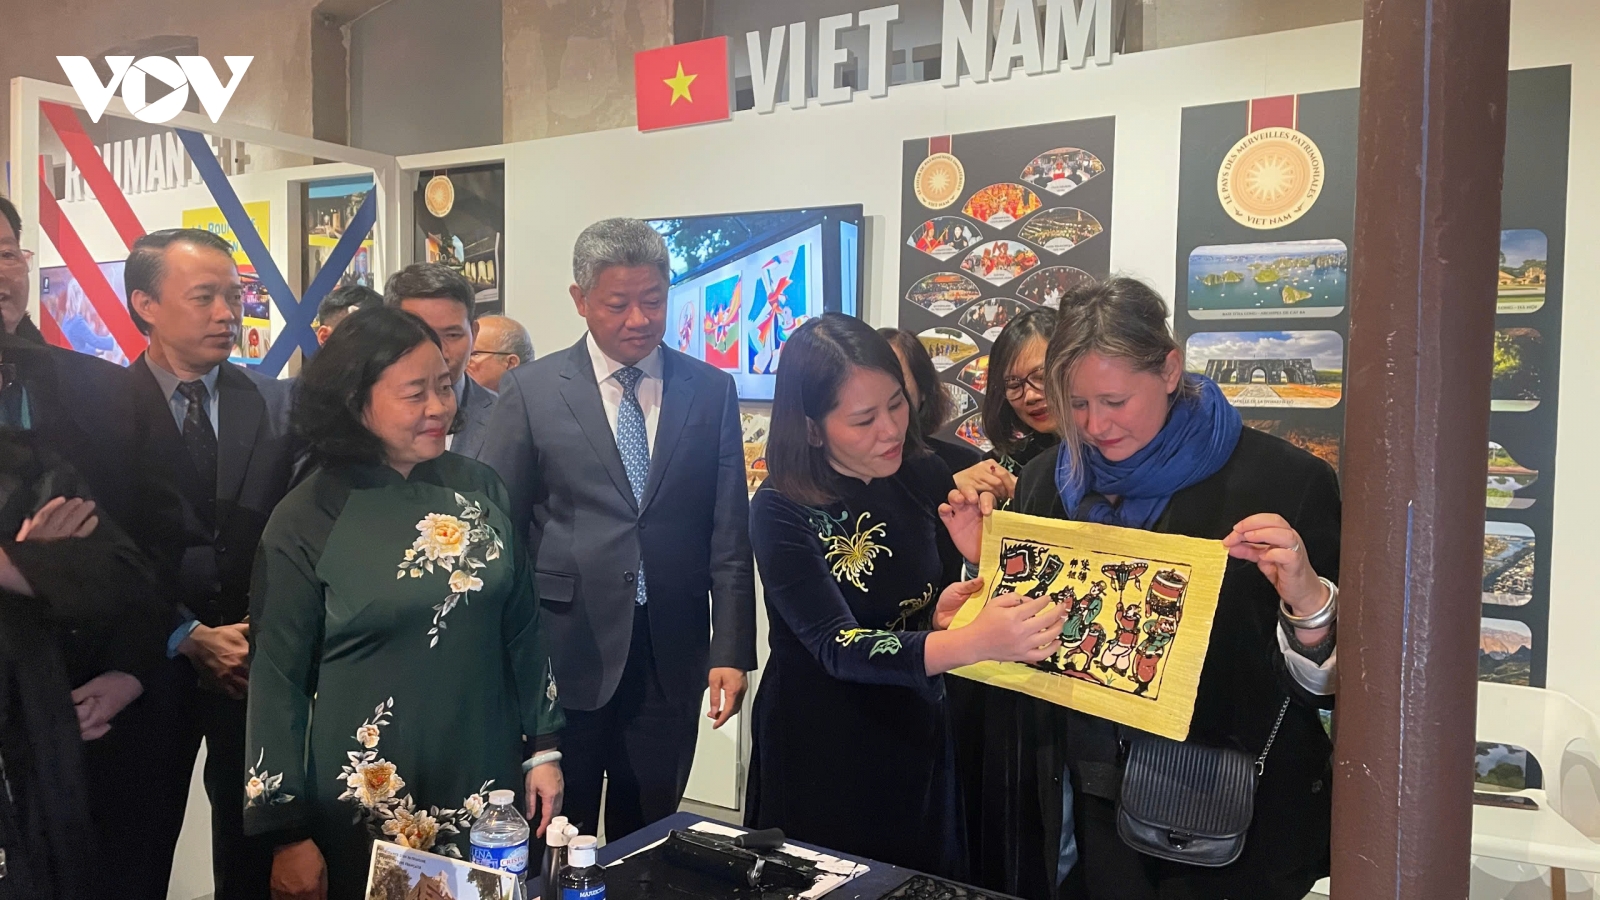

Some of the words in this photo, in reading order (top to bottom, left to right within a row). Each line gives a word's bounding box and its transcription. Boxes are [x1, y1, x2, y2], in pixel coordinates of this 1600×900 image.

[745, 4, 899, 113] VIET
[941, 0, 1113, 87] NAM
[1236, 131, 1291, 155] MERVEILLES
[1224, 153, 1238, 170] DES
[1290, 134, 1320, 199] PATRIMONIALES
[1221, 171, 1230, 193] PAYS
[1223, 193, 1233, 205] LE
[1246, 215, 1266, 226] VIET
[1268, 212, 1293, 225] NAM
